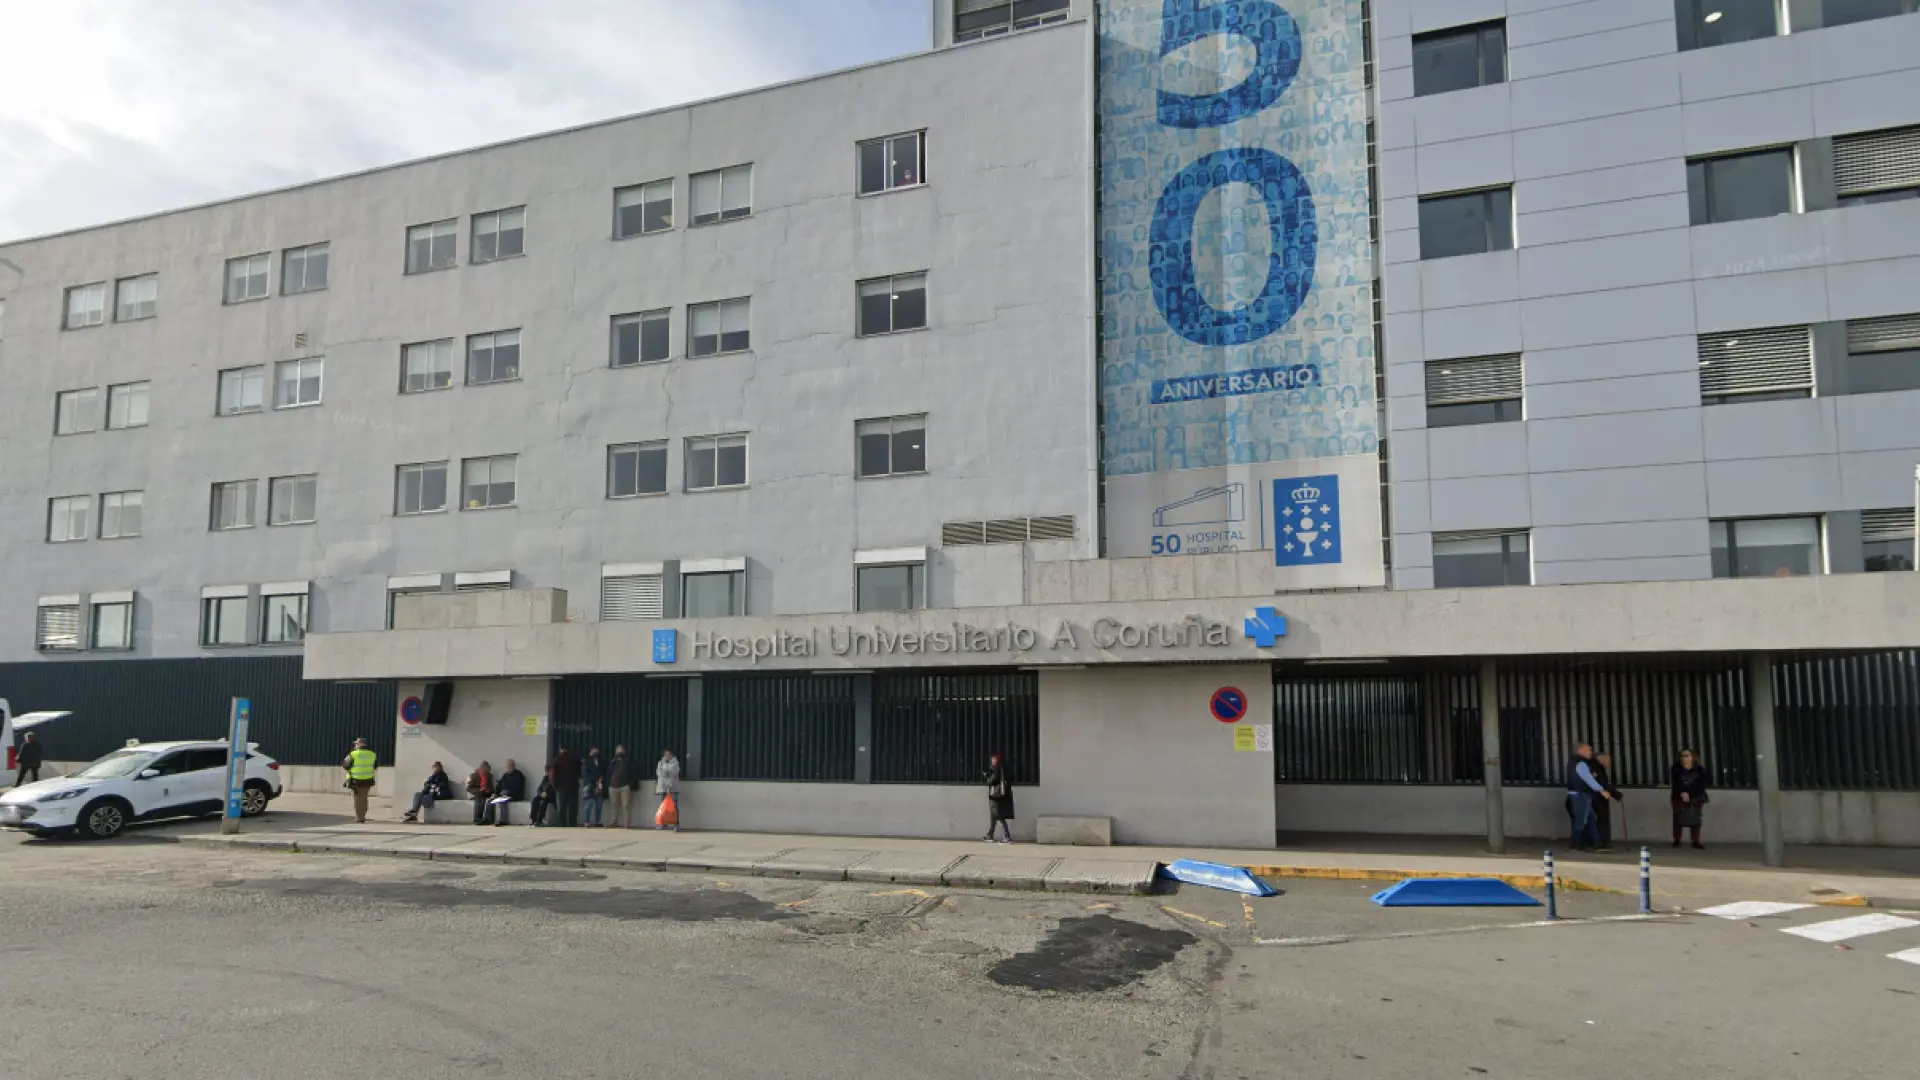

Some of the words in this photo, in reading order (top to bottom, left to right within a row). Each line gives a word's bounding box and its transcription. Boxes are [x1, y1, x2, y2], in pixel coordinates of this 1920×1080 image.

[1160, 367, 1312, 400] ANIVERSARIO
[1150, 534, 1181, 555] 50
[1187, 531, 1245, 543] HOSPITAL
[691, 626, 817, 665] Hospital
[829, 620, 1036, 656] Universitario
[1051, 617, 1077, 651] A
[1091, 613, 1229, 650] Coruña
